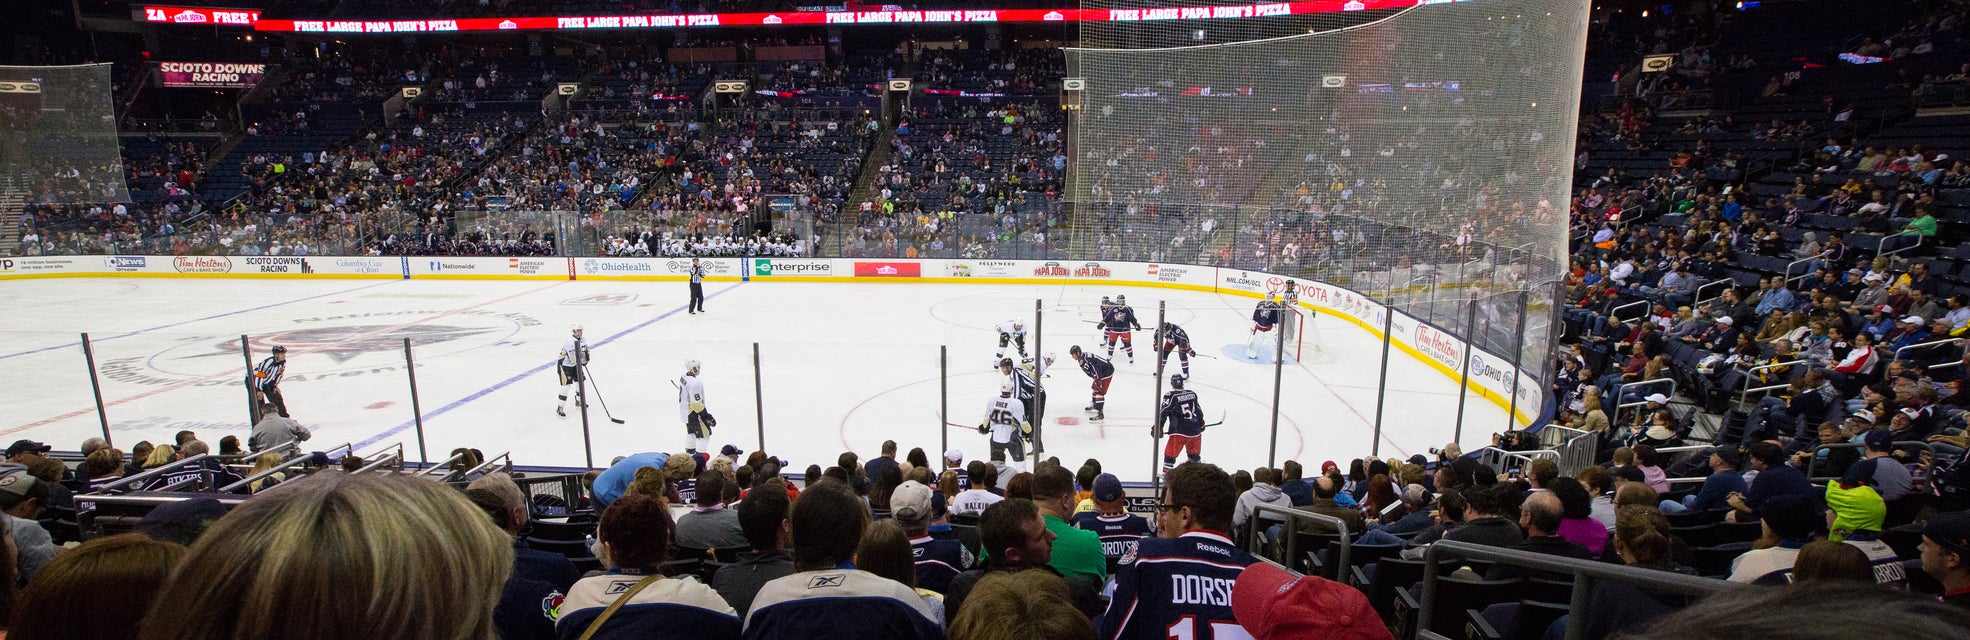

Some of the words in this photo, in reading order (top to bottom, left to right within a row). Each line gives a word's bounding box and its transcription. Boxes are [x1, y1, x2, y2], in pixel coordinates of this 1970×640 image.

[213, 11, 250, 24] FREE
[826, 12, 854, 23] FREE
[857, 12, 892, 23] LARGE
[895, 11, 922, 22] PAPA
[925, 10, 961, 22] JOHN'S
[965, 10, 997, 21] PIZZA
[1110, 10, 1139, 20] FREE
[1142, 9, 1179, 20] LARGE
[1182, 8, 1211, 19] PAPA
[1214, 6, 1251, 18] JOHN'S
[1256, 3, 1291, 16] PIZZA
[294, 21, 323, 32] FREE
[327, 22, 362, 32] LARGE
[366, 22, 391, 32] PAPA
[394, 21, 425, 32] JOHN'S
[428, 20, 458, 31] PIZZA
[558, 18, 584, 28] FREE
[587, 17, 620, 28] LARGE
[623, 16, 648, 27] PAPA
[651, 16, 685, 26] JOHN'S
[688, 15, 719, 26] PIZZA
[161, 62, 212, 73] SCIOTO
[215, 64, 265, 74] DOWNS
[192, 74, 239, 82] RACINO
[0, 259, 14, 270] p
[178, 257, 194, 268] Tim
[195, 256, 227, 268] Hortons
[336, 259, 368, 267] Columbia
[601, 262, 651, 271] OhioHealth
[756, 262, 830, 272] enterprise
[1034, 266, 1050, 276] PAPA
[1074, 267, 1090, 276] PAPA
[1293, 283, 1328, 302] OYOTA
[1419, 326, 1431, 346] Tim
[1432, 330, 1458, 360] Hortons
[1484, 365, 1502, 382] OHIO
[694, 394, 700, 402] 8
[990, 409, 1012, 425] 46
[1196, 542, 1232, 558] Reebok
